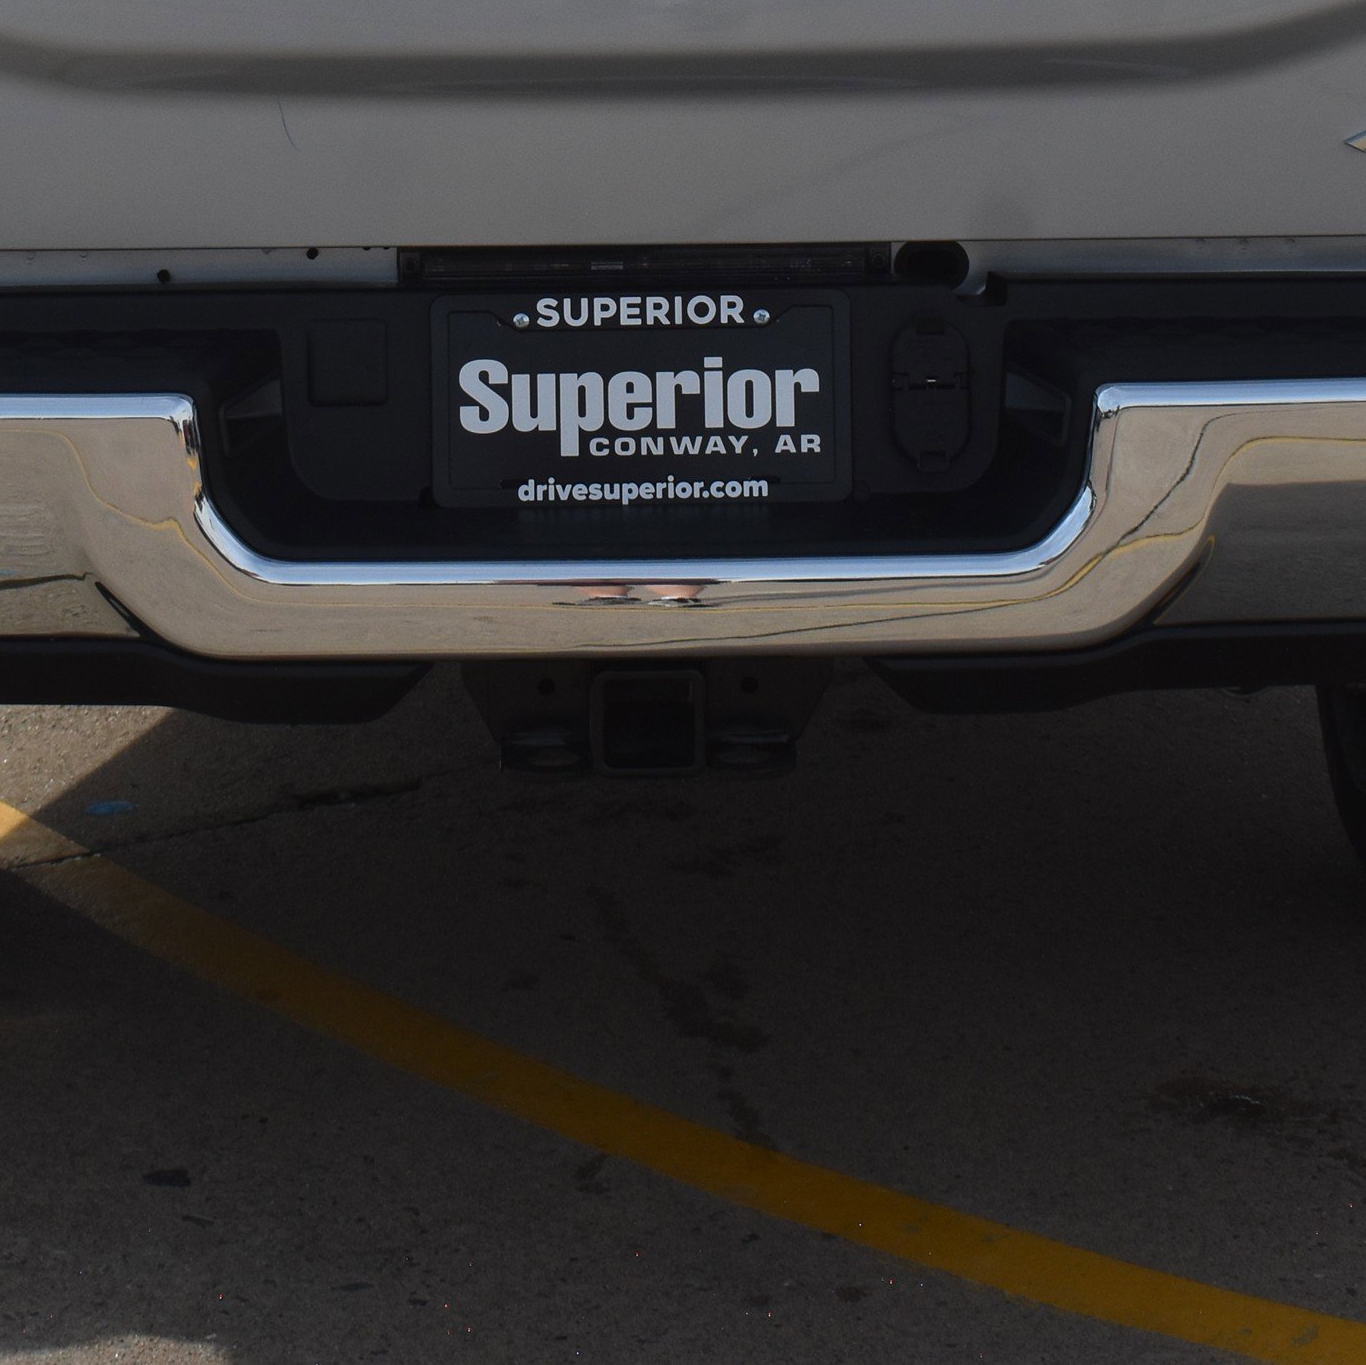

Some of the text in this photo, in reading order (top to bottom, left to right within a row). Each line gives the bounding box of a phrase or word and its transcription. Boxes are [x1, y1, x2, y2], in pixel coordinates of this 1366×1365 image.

[536, 294, 745, 328] SUPERIOR
[458, 356, 820, 457] Superior
[589, 434, 822, 457] CONWAY, AR
[517, 475, 770, 505] drivesuperior.com
